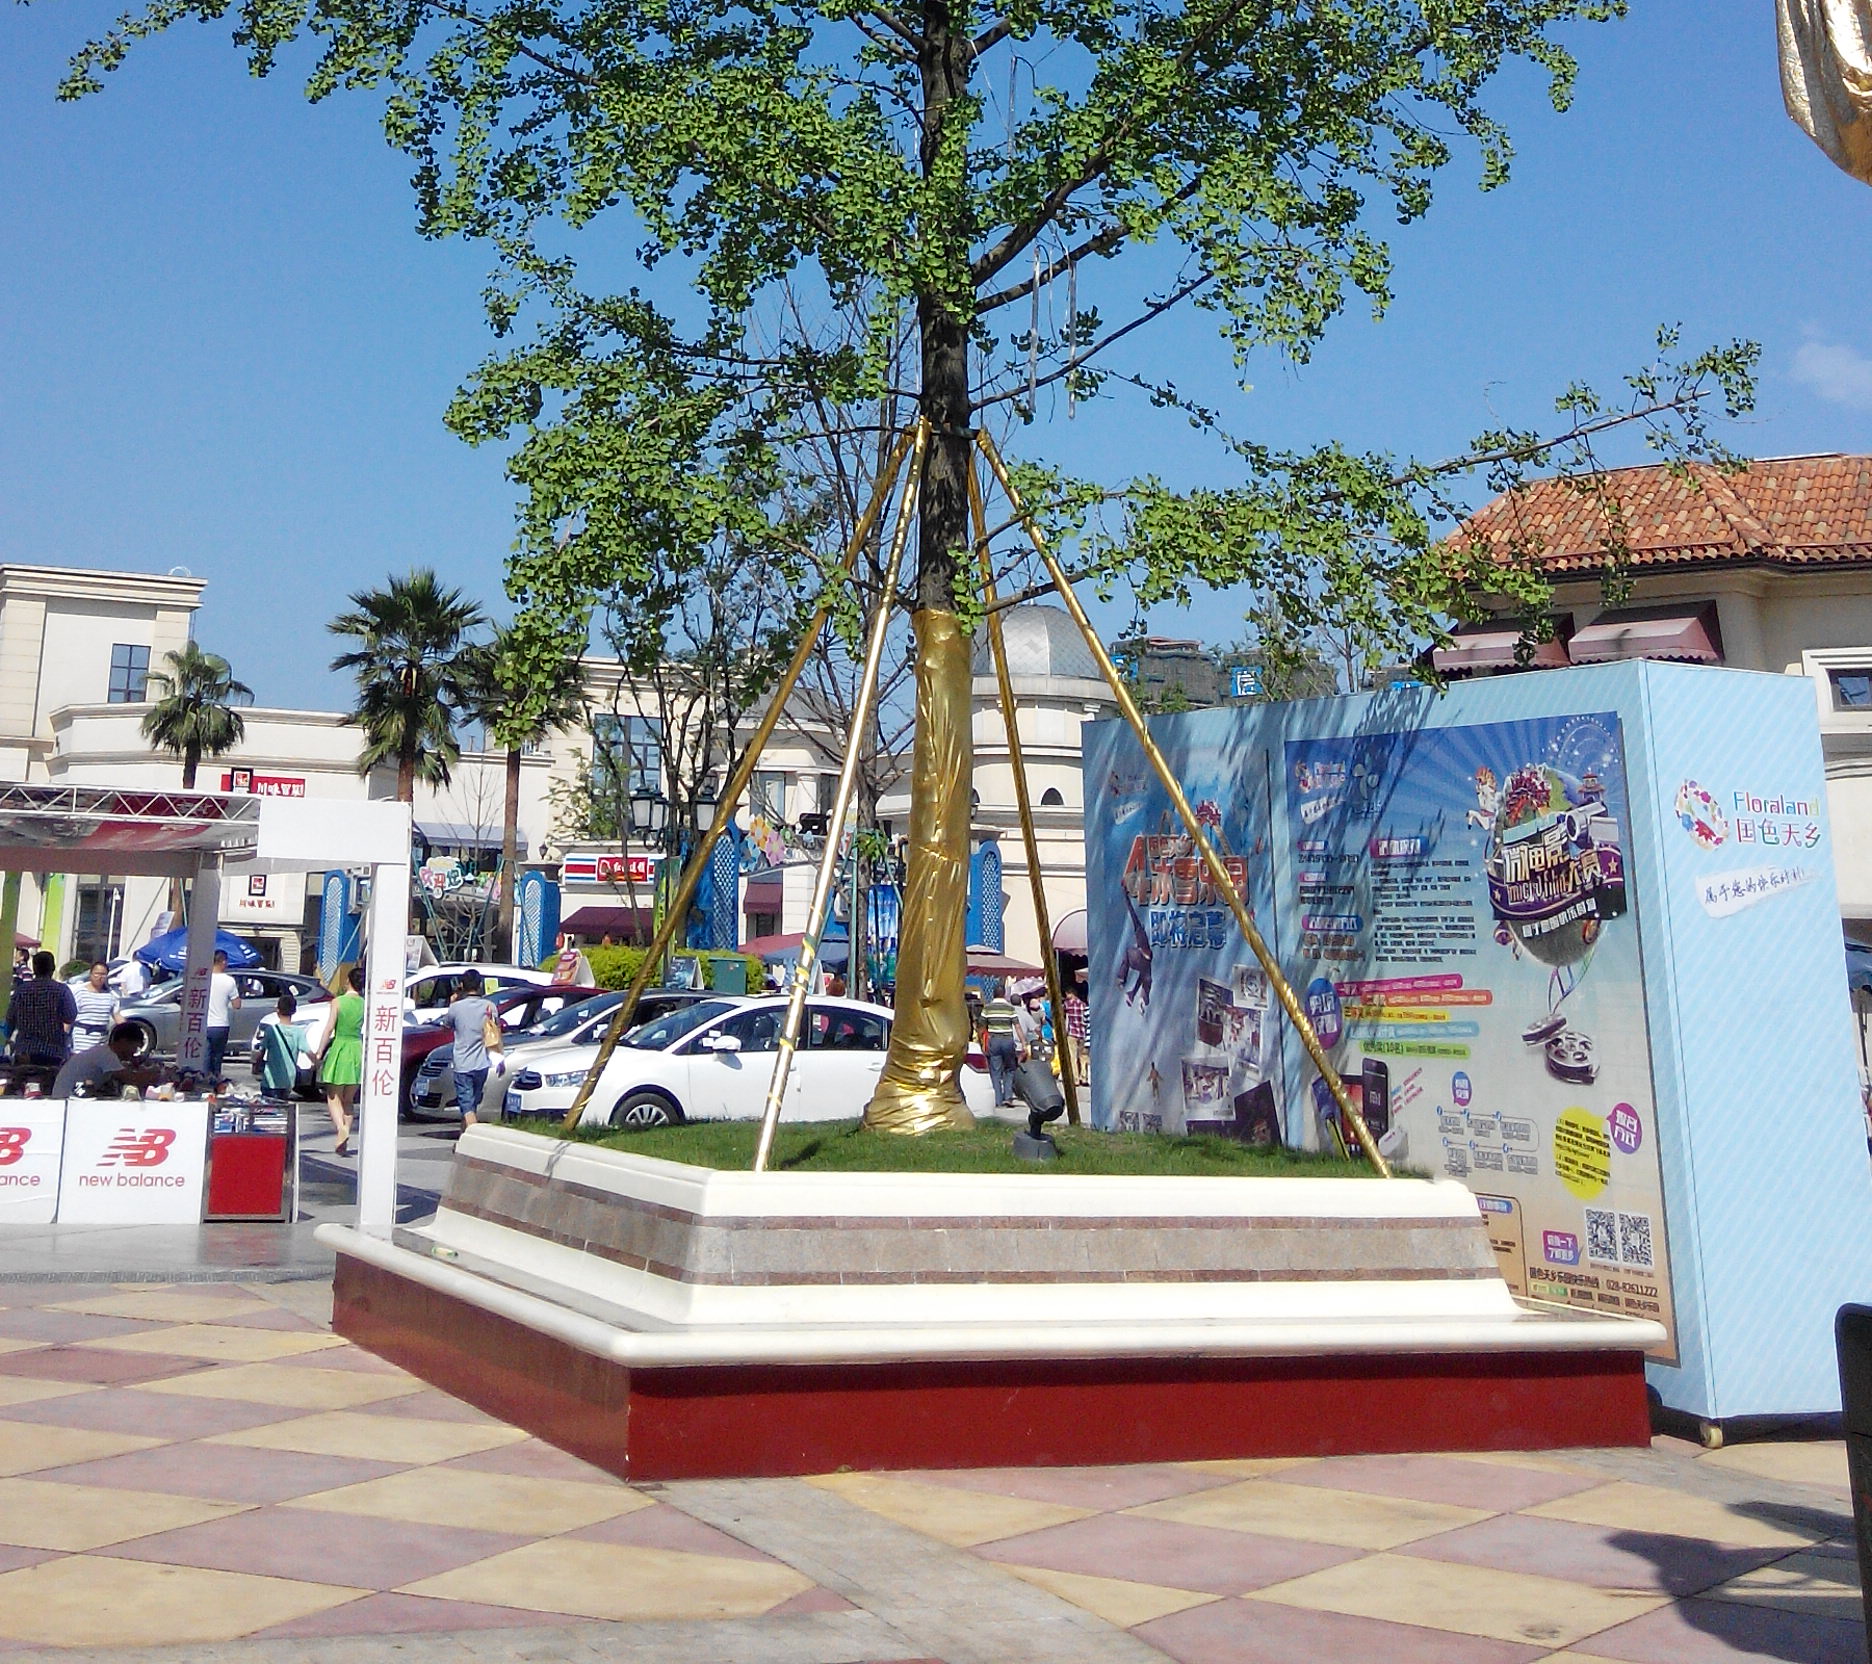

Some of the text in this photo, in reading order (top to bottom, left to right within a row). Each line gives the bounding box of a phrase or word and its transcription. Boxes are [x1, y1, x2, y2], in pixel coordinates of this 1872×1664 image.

[1734, 791, 1820, 816] Floraland
[1736, 818, 1821, 848] 国色天乡
[185, 987, 208, 1059] 新百伦
[373, 1005, 398, 1097] 新百伦
[0, 1174, 41, 1186] ance
[79, 1172, 185, 1187] new balance
